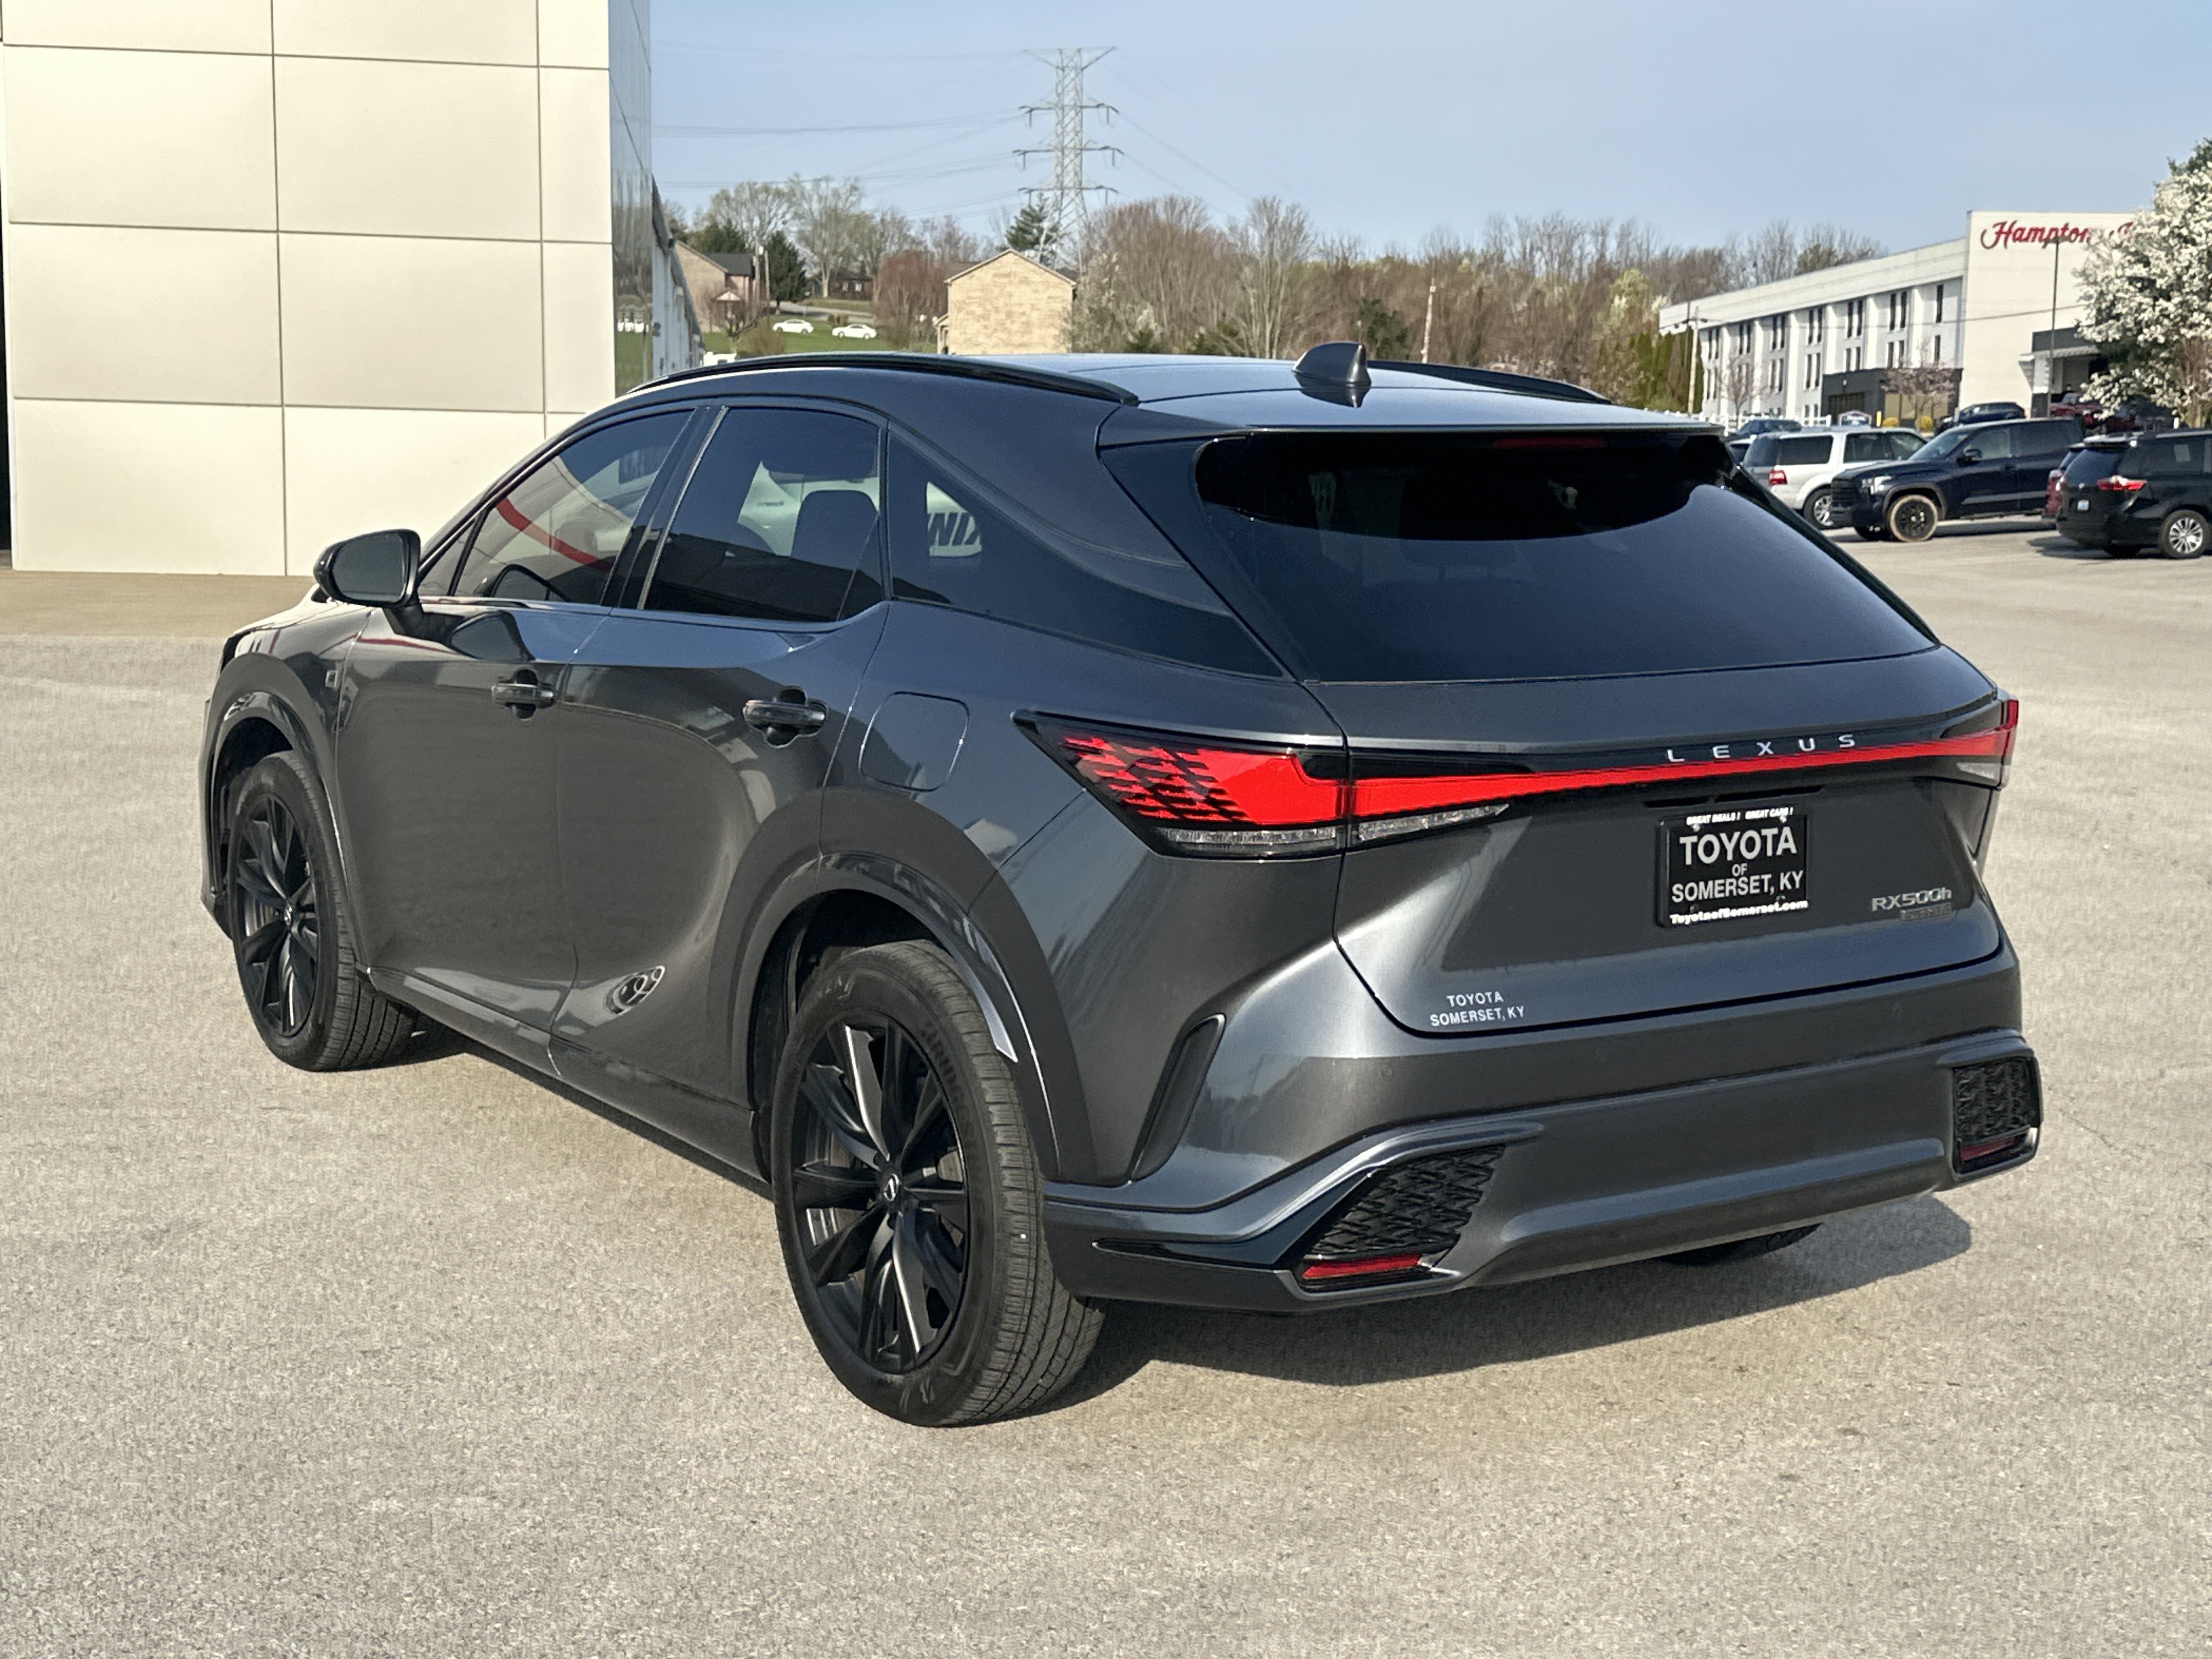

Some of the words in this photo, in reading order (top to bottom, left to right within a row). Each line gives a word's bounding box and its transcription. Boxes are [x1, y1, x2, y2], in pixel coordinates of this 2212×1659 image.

[1667, 734, 1855, 763] LEXUS
[1679, 826, 1797, 865] TOYOTA
[1731, 863, 1748, 877] OF
[1672, 874, 1775, 902] SOMERSET,
[1780, 870, 1804, 890] KY
[1871, 887, 1953, 912] RX500h
[1446, 991, 1504, 1007] TOYOTA
[1430, 1007, 1506, 1027] SOMERSET,
[1507, 1005, 1525, 1019] KY
